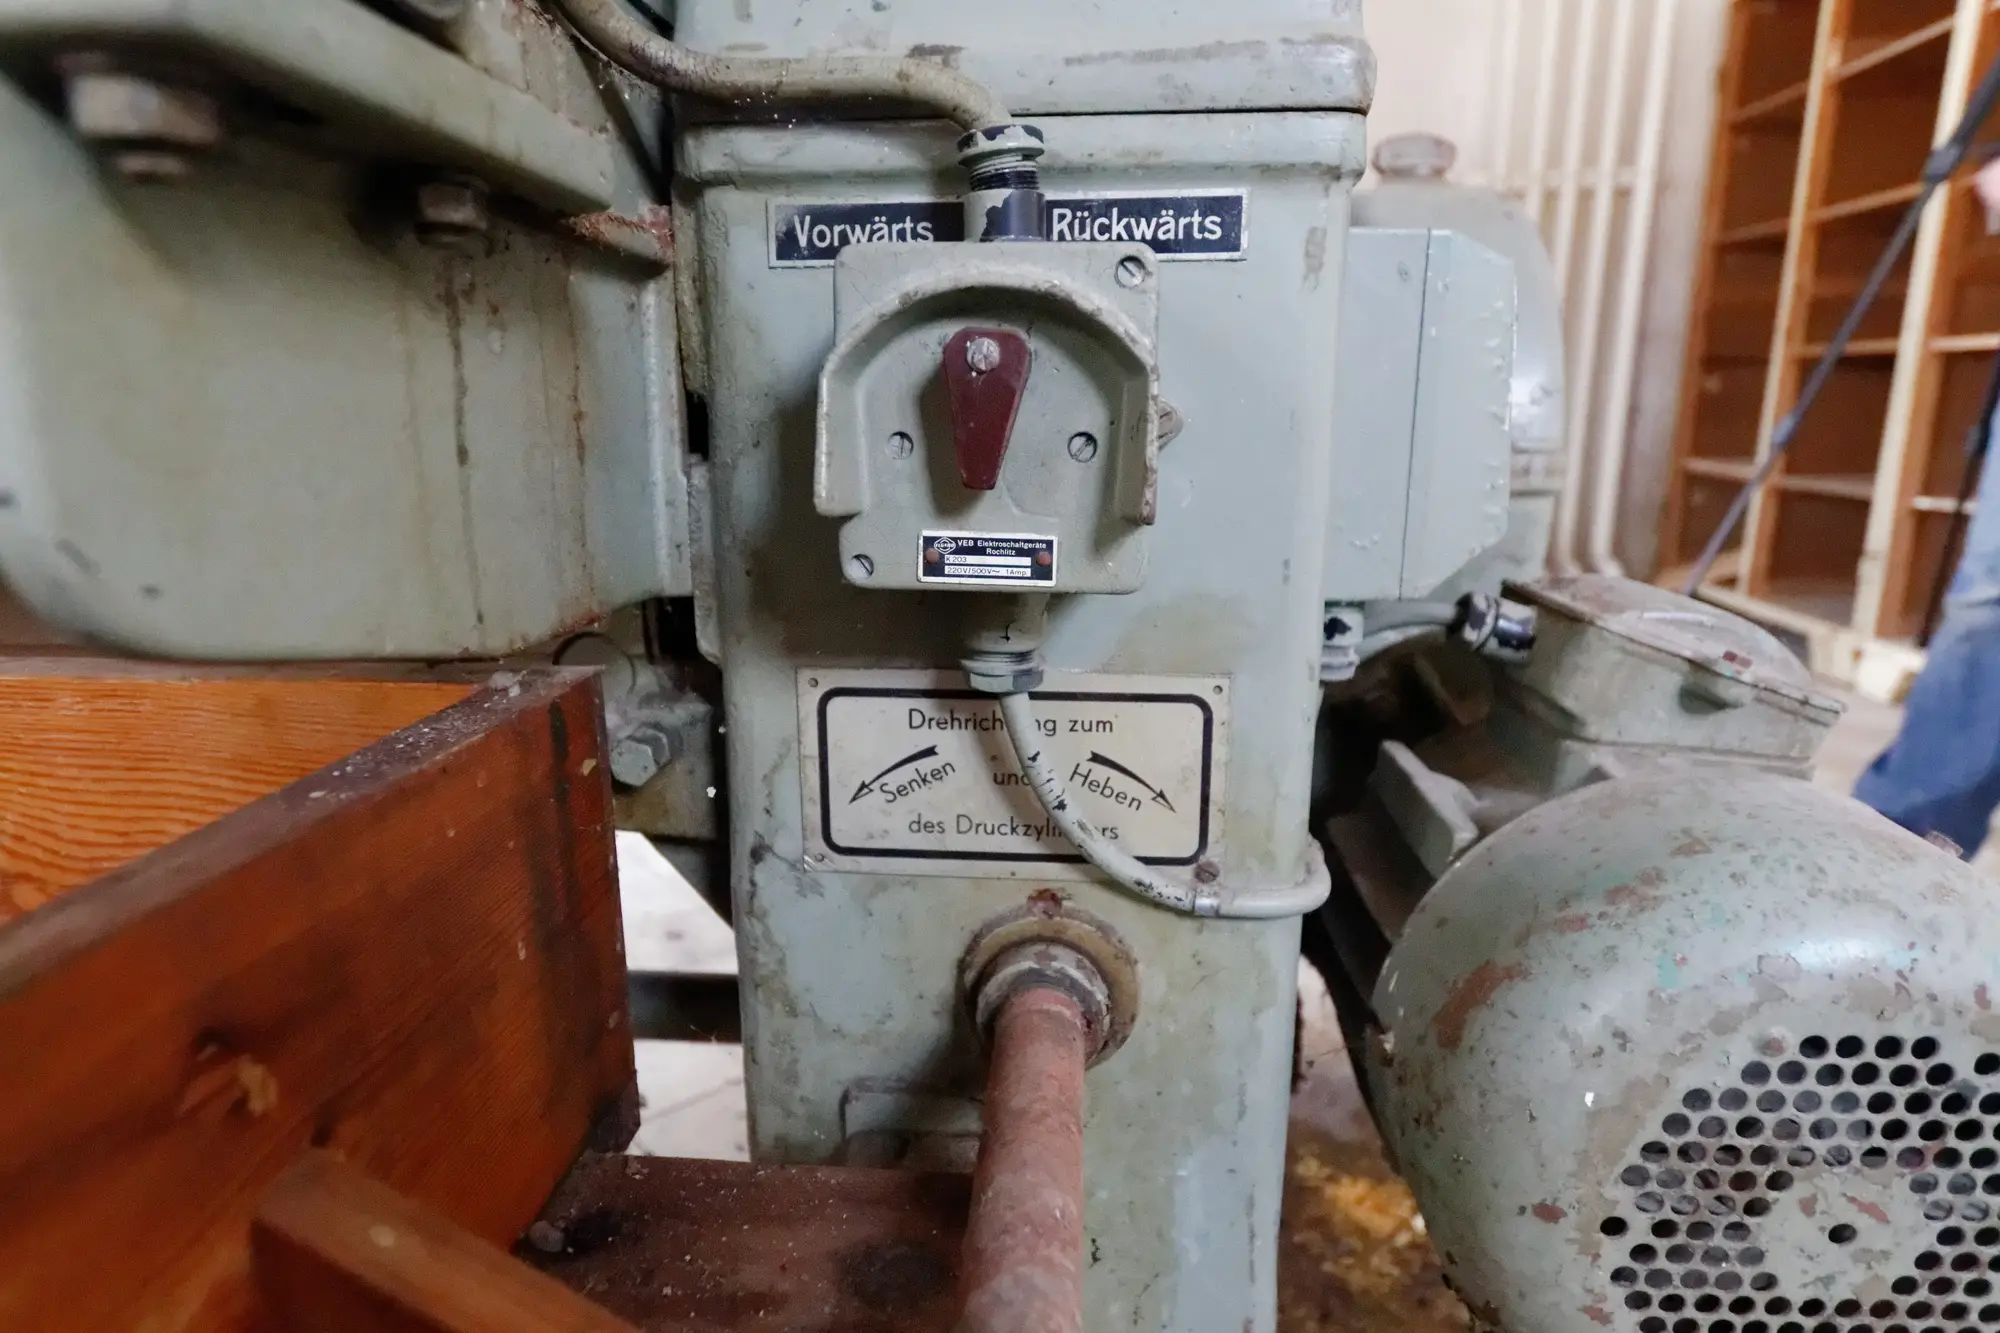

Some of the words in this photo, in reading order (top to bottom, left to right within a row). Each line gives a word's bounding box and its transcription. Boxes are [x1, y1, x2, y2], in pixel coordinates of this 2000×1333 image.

[793, 215, 933, 248] Vorwärts
[1052, 207, 1222, 241] Rückwärts
[957, 539, 974, 547] VEB
[977, 540, 1047, 550] Elektroschaltgeräte
[986, 548, 1016, 556] Rochlitz
[908, 708, 1056, 737] Drehrichng
[1068, 719, 1114, 733] zum
[879, 760, 956, 805] Senken
[1069, 763, 1143, 812] Heben
[908, 813, 946, 835] des
[956, 814, 1120, 842] Druckzylirs
